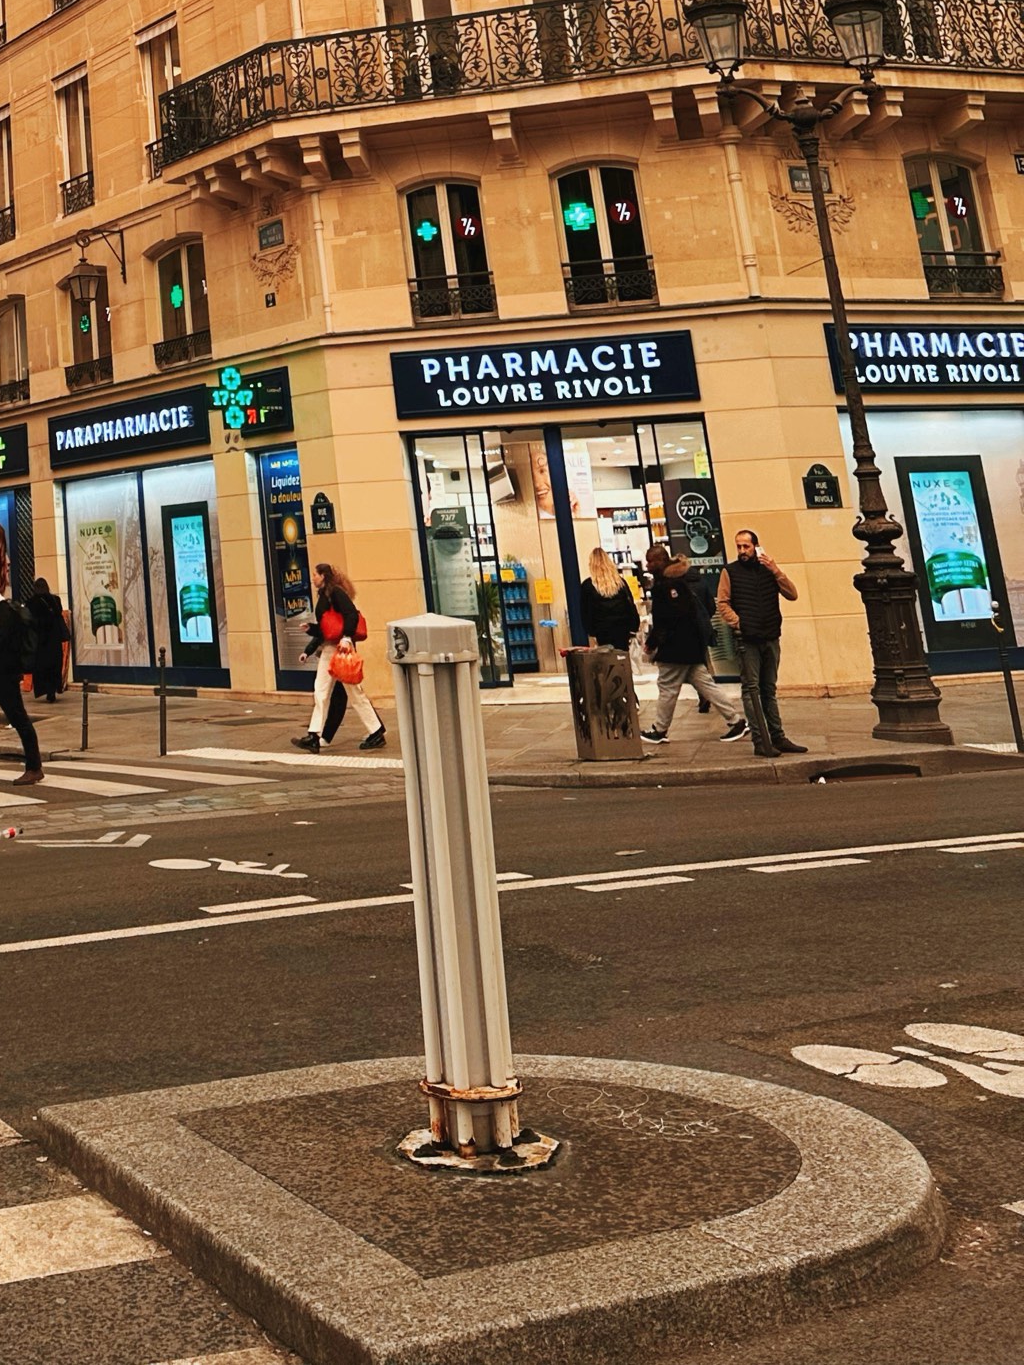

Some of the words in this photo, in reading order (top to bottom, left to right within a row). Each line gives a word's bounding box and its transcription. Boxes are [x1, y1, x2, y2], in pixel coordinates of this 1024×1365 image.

[421, 341, 661, 384] PHARMACIE
[855, 364, 940, 383] LOUVRE
[946, 364, 1021, 382] RIVOLI
[437, 382, 544, 407] LOUVRE
[555, 375, 653, 399] RIVOLI
[212, 390, 253, 406] 17:47
[56, 405, 192, 451] PARAPHARMACIE
[271, 475, 300, 490] Liquidez
[913, 479, 951, 489] NUXE
[270, 493, 277, 503] la
[680, 505, 705, 516] 7J/7
[440, 514, 456, 522] 7J/7
[79, 527, 104, 537] NUXE
[174, 522, 195, 531] NUXE
[285, 570, 302, 583] Advil
